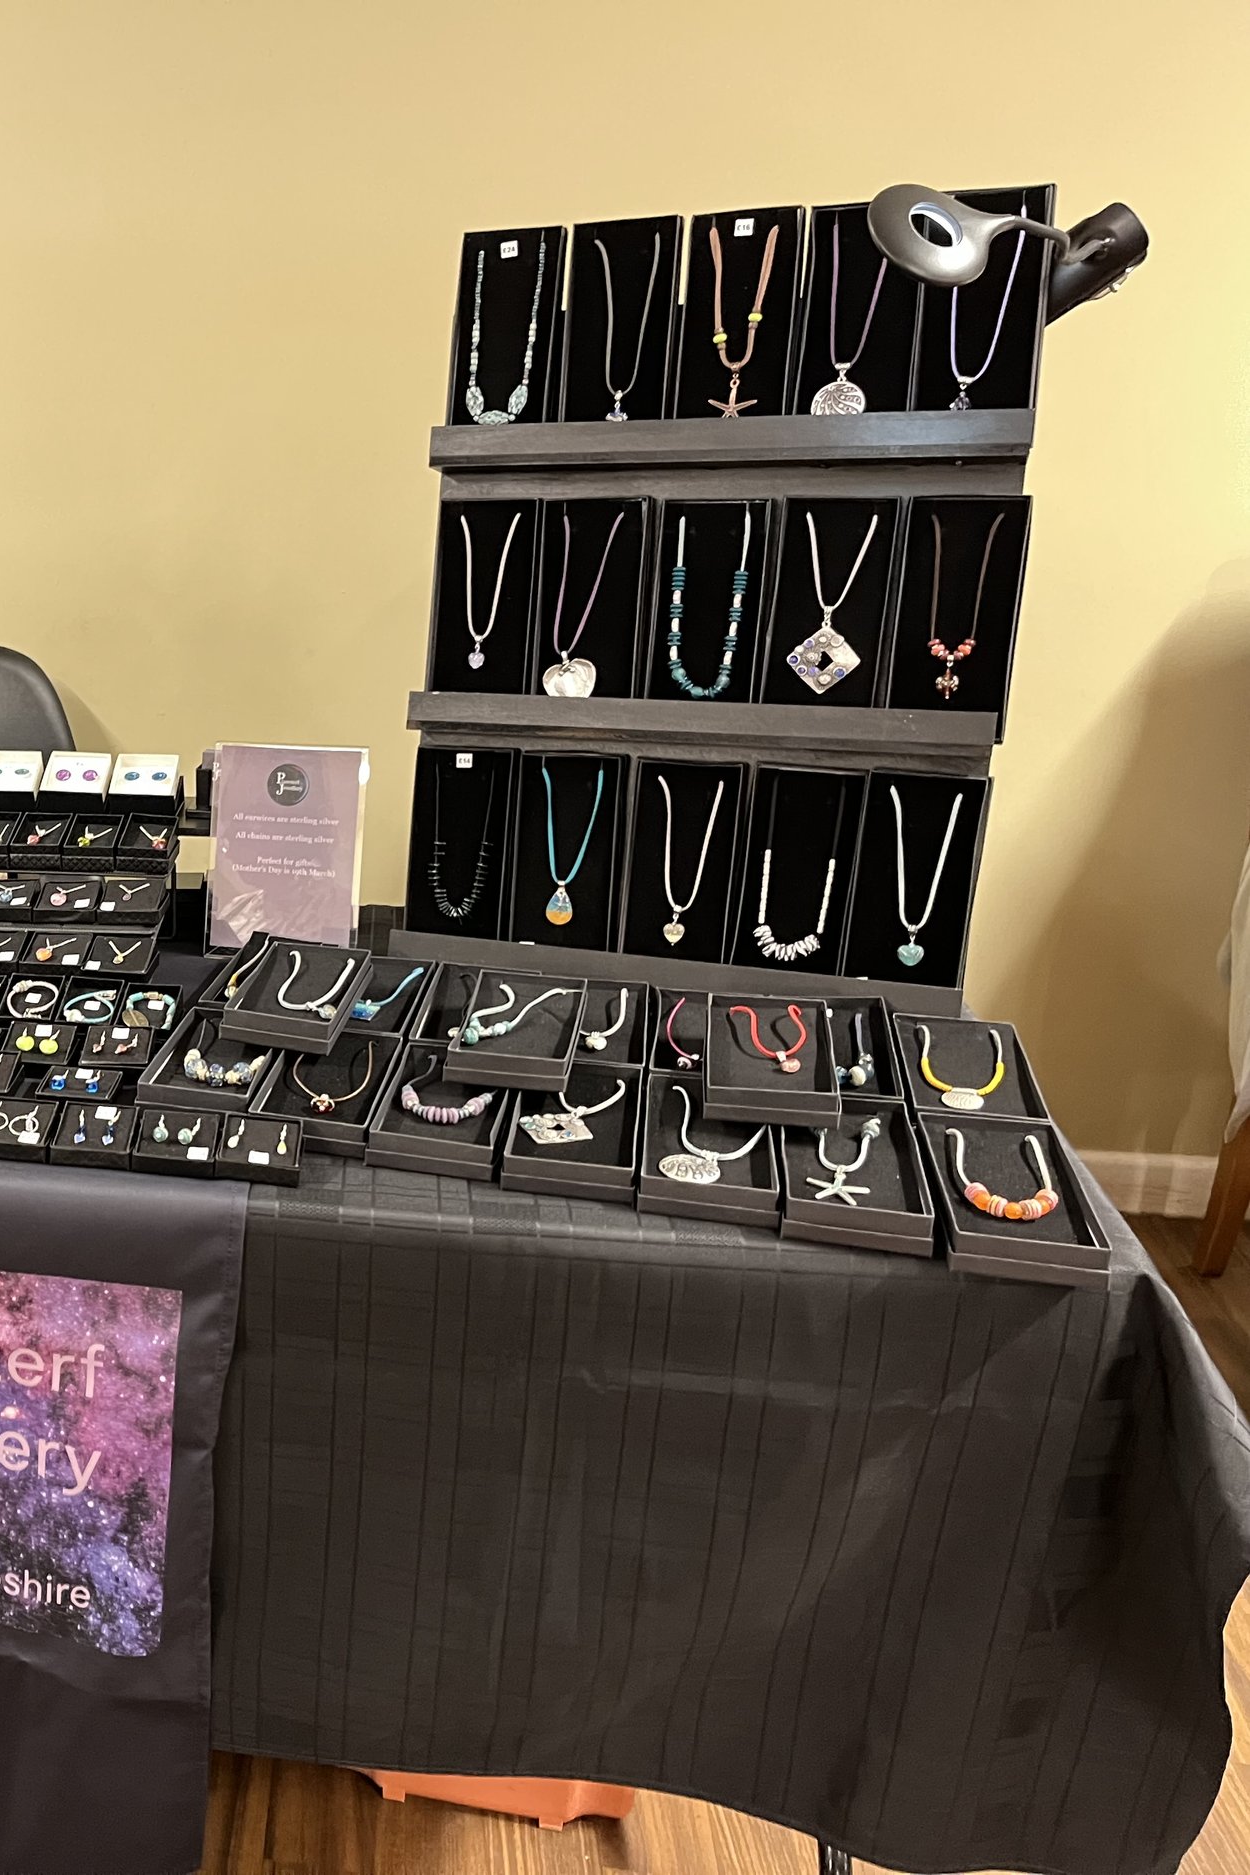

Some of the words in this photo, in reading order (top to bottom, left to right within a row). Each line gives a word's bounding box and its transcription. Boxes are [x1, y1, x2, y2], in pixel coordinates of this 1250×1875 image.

[233, 812, 244, 820] All
[289, 816, 318, 826] sterling
[318, 817, 340, 825] silver
[235, 831, 246, 839] All
[247, 831, 271, 841] chains
[284, 834, 313, 844] sterling
[313, 835, 335, 844] silver
[256, 856, 282, 865] Perfect
[283, 856, 294, 866] for
[232, 863, 267, 873] (Mother's
[268, 866, 282, 875] Day
[309, 868, 336, 878] March)
